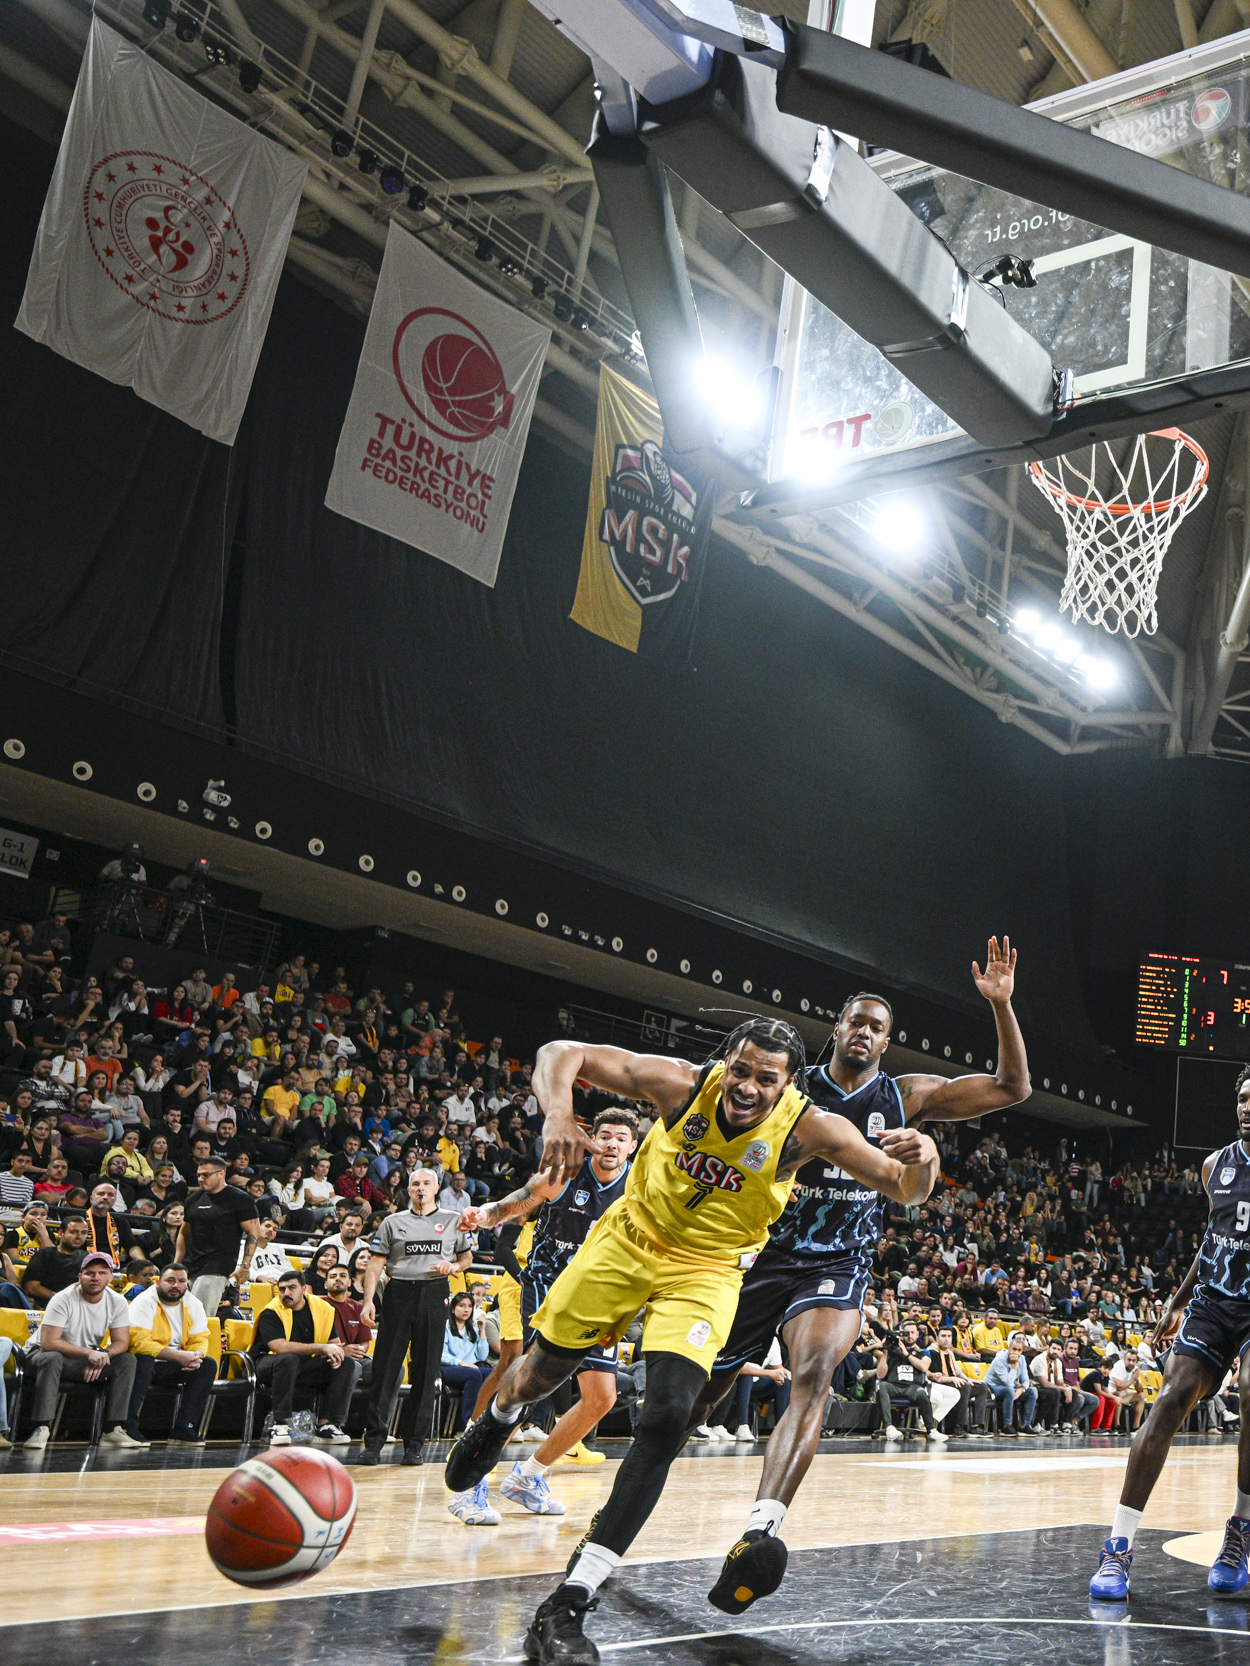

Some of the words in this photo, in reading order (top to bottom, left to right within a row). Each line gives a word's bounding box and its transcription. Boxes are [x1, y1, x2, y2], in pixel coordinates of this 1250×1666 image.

[113, 183, 163, 225] CUMHURİYETİ
[166, 187, 208, 223] GENÇLİK
[206, 225, 219, 239] VE
[116, 227, 147, 275] TÜRKİYE
[375, 412, 496, 500] TÜRKİYE
[366, 437, 488, 519] BASKETBOL
[360, 457, 486, 534] FEDERASYONU
[602, 508, 691, 582] MSK
[0, 853, 28, 869] LOK
[1220, 970, 1228, 985] 7
[1206, 1011, 1215, 1025] 3
[683, 1124, 705, 1139] MSK
[675, 1152, 746, 1192] MSK
[685, 1181, 715, 1209] 7
[828, 1187, 878, 1200] Telekom
[1235, 1201, 1250, 1232] 9
[20, 1248, 39, 1256] MS
